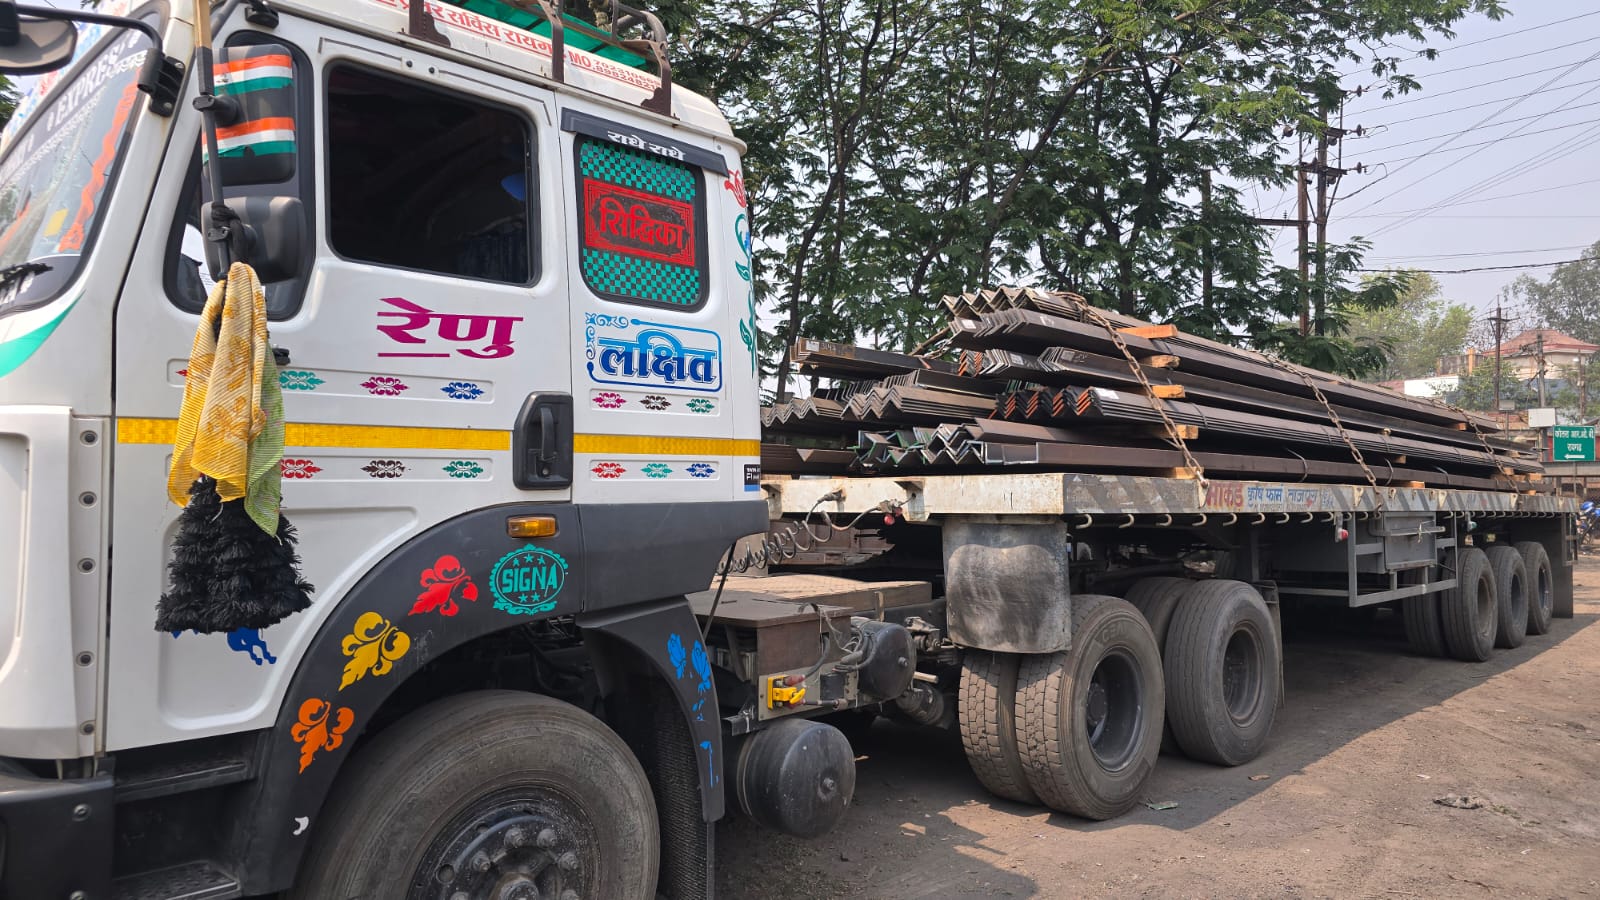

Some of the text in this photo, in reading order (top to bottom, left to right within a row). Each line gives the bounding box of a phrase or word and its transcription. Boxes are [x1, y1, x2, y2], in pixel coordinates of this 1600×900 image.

[607, 130, 686, 161] राधे राधे
[376, 297, 524, 359] रेणु
[501, 562, 558, 597] SIGNA
